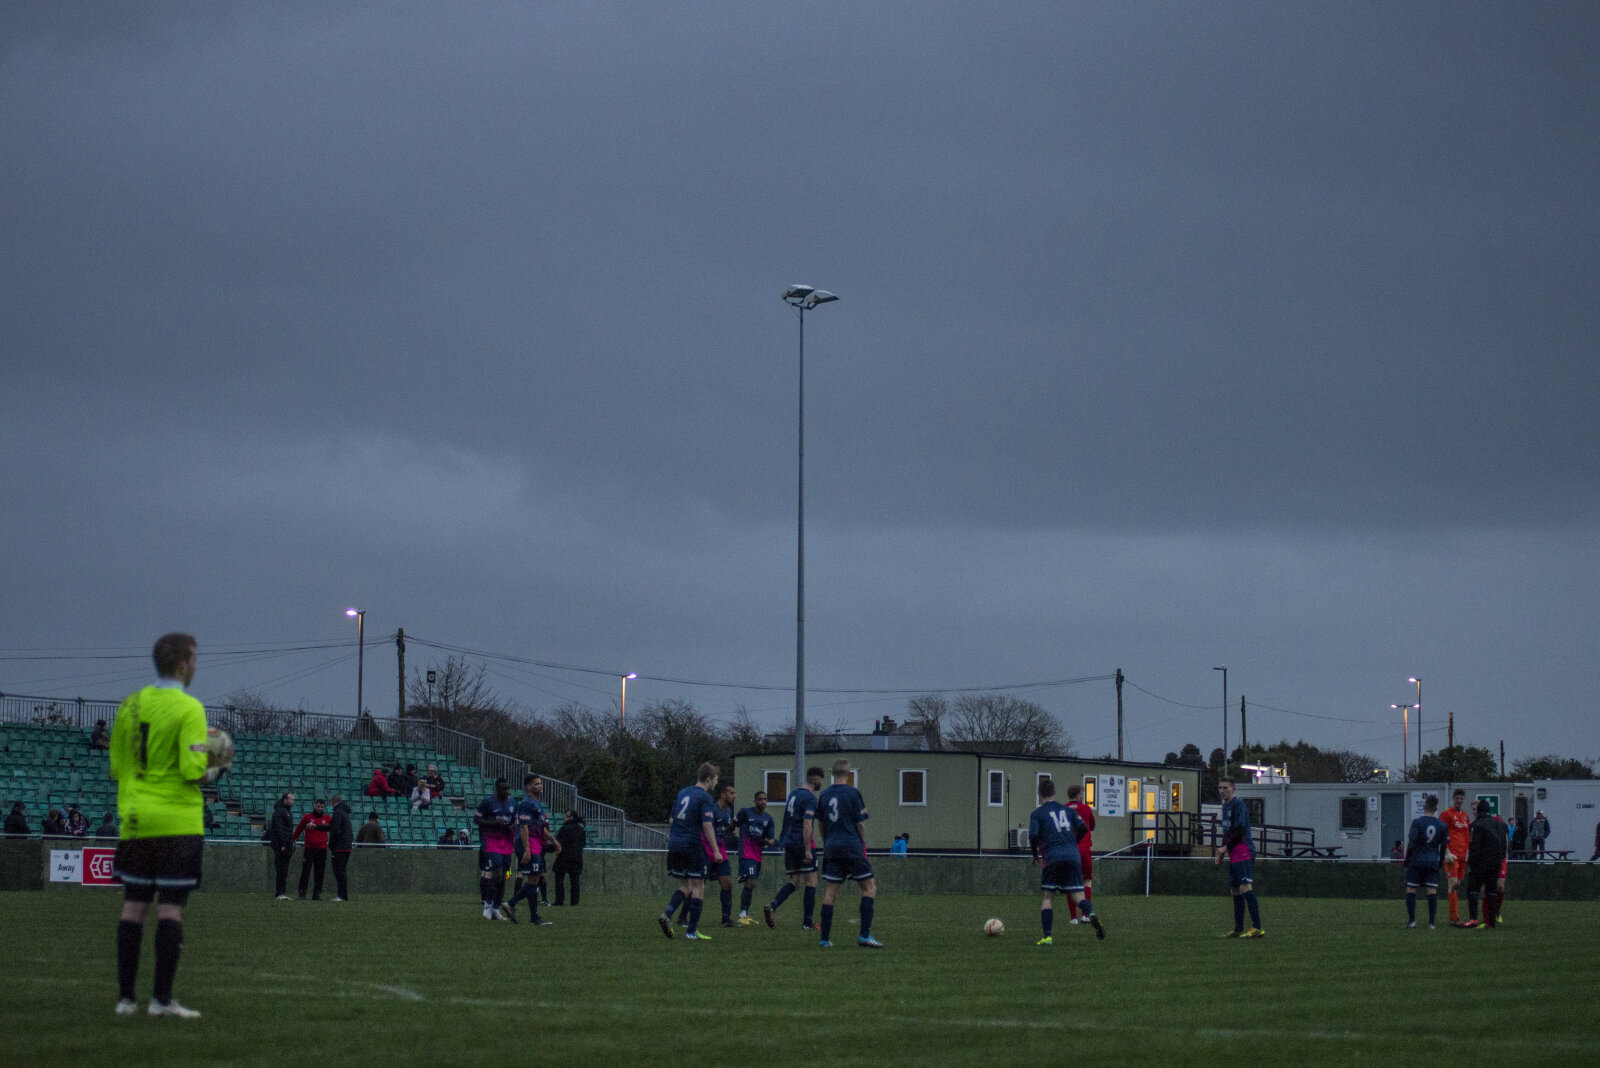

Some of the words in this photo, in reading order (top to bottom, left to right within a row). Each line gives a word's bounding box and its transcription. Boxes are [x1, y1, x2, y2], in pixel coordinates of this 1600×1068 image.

[140, 722, 149, 770] 1
[677, 796, 690, 820] 2
[787, 796, 796, 816] 4
[828, 797, 839, 823] 3
[1049, 809, 1071, 833] 14
[1426, 825, 1436, 844] 9
[57, 863, 75, 873] Away
[102, 860, 114, 873] E
[532, 863, 540, 872] 12
